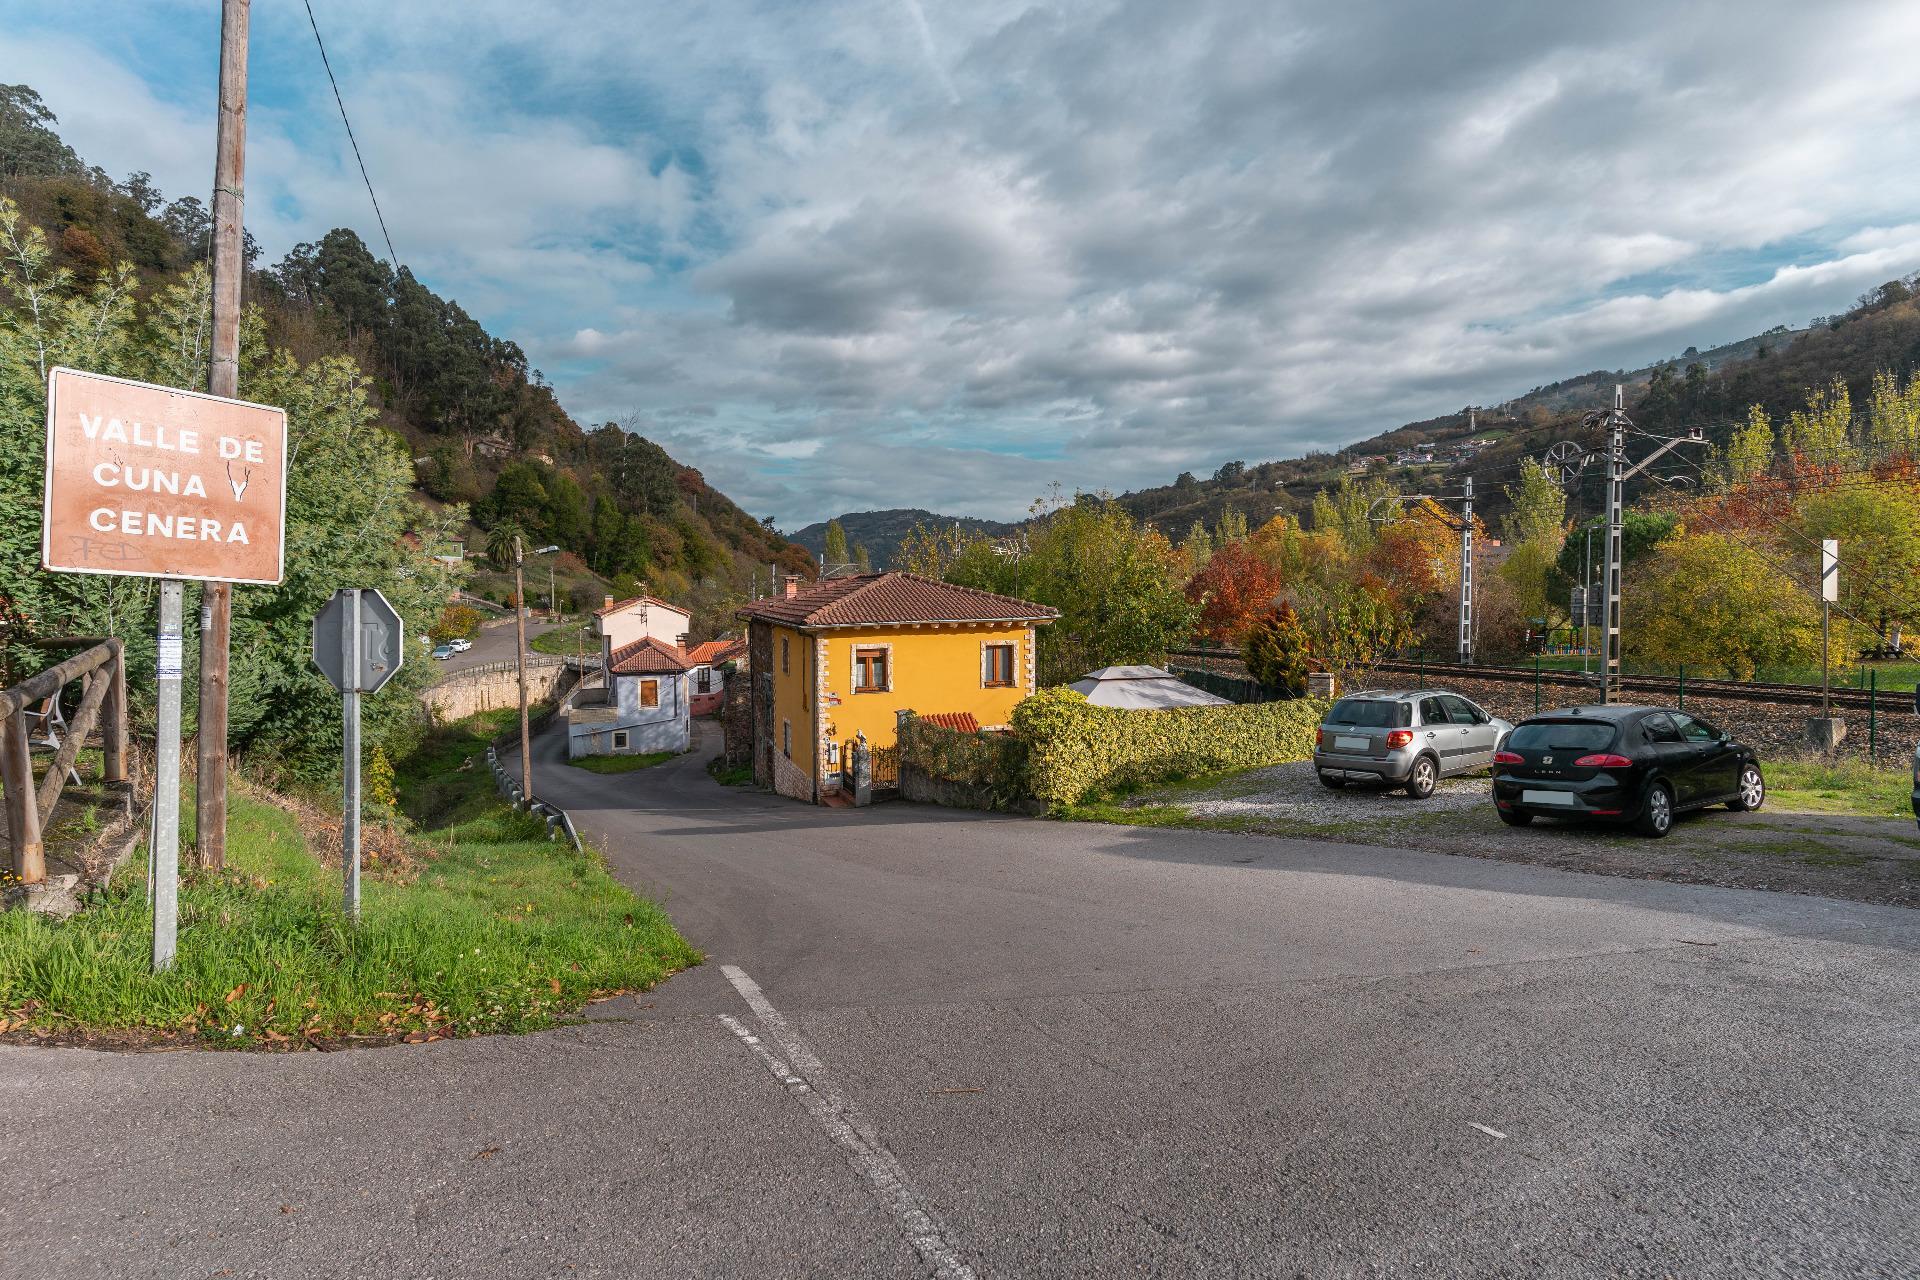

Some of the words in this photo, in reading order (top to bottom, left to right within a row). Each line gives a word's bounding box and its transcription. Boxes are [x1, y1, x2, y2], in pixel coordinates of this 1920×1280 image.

[79, 413, 200, 454] VALLE
[219, 436, 264, 463] DE
[92, 462, 207, 498] CUNA
[228, 479, 249, 502] Y
[89, 507, 250, 545] CENERA
